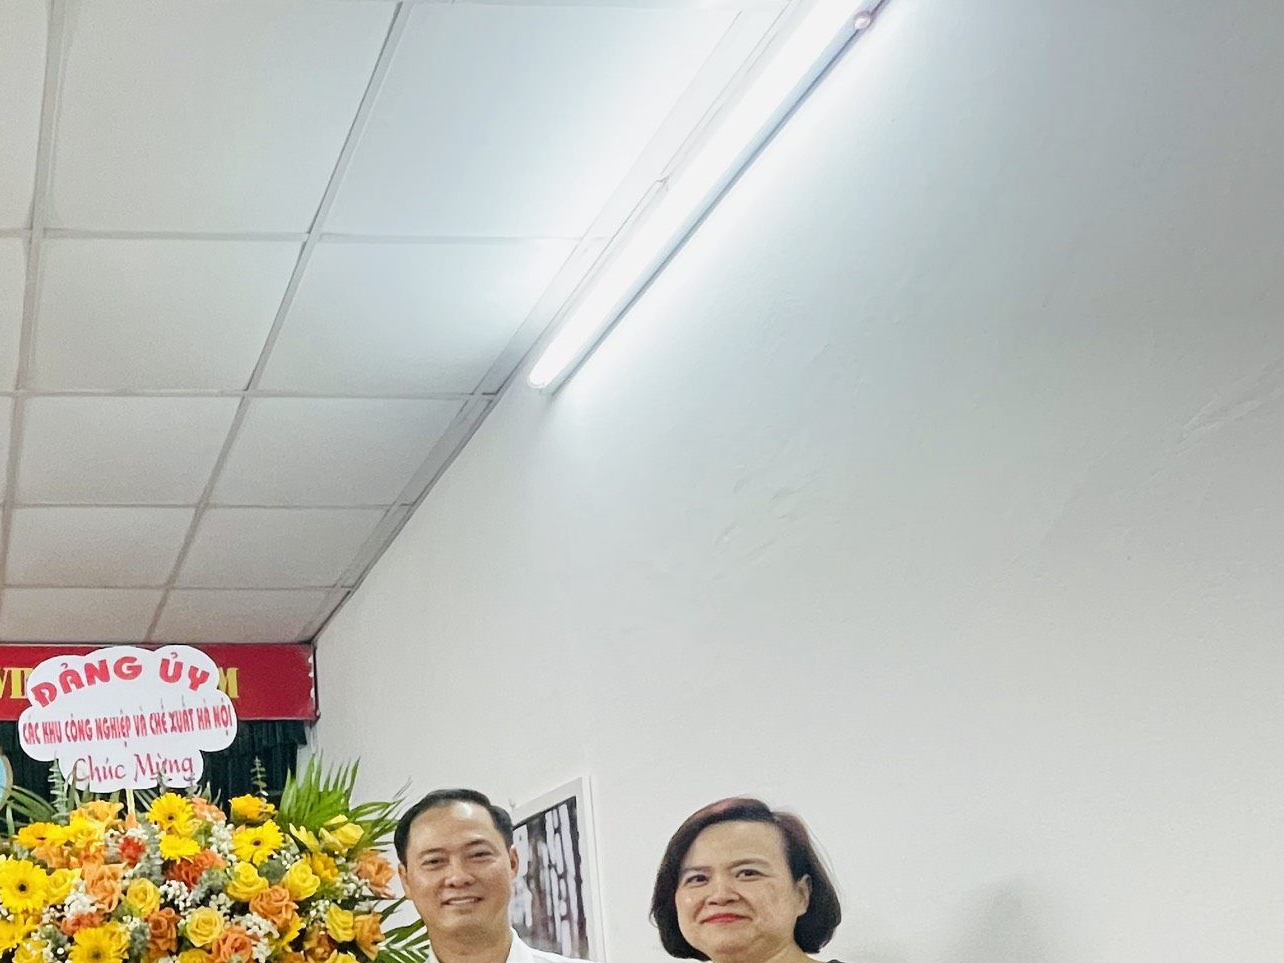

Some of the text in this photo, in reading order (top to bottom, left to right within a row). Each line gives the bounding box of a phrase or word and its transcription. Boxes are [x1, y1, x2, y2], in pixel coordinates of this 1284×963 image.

[30, 656, 142, 708] ĐẢNG
[158, 651, 210, 692] ỦY
[22, 695, 233, 748] CÁC KHU CÔNG NGHIỆP VÀ CHẾ XUẤT HÀ NỘI
[73, 754, 126, 784] Chúc
